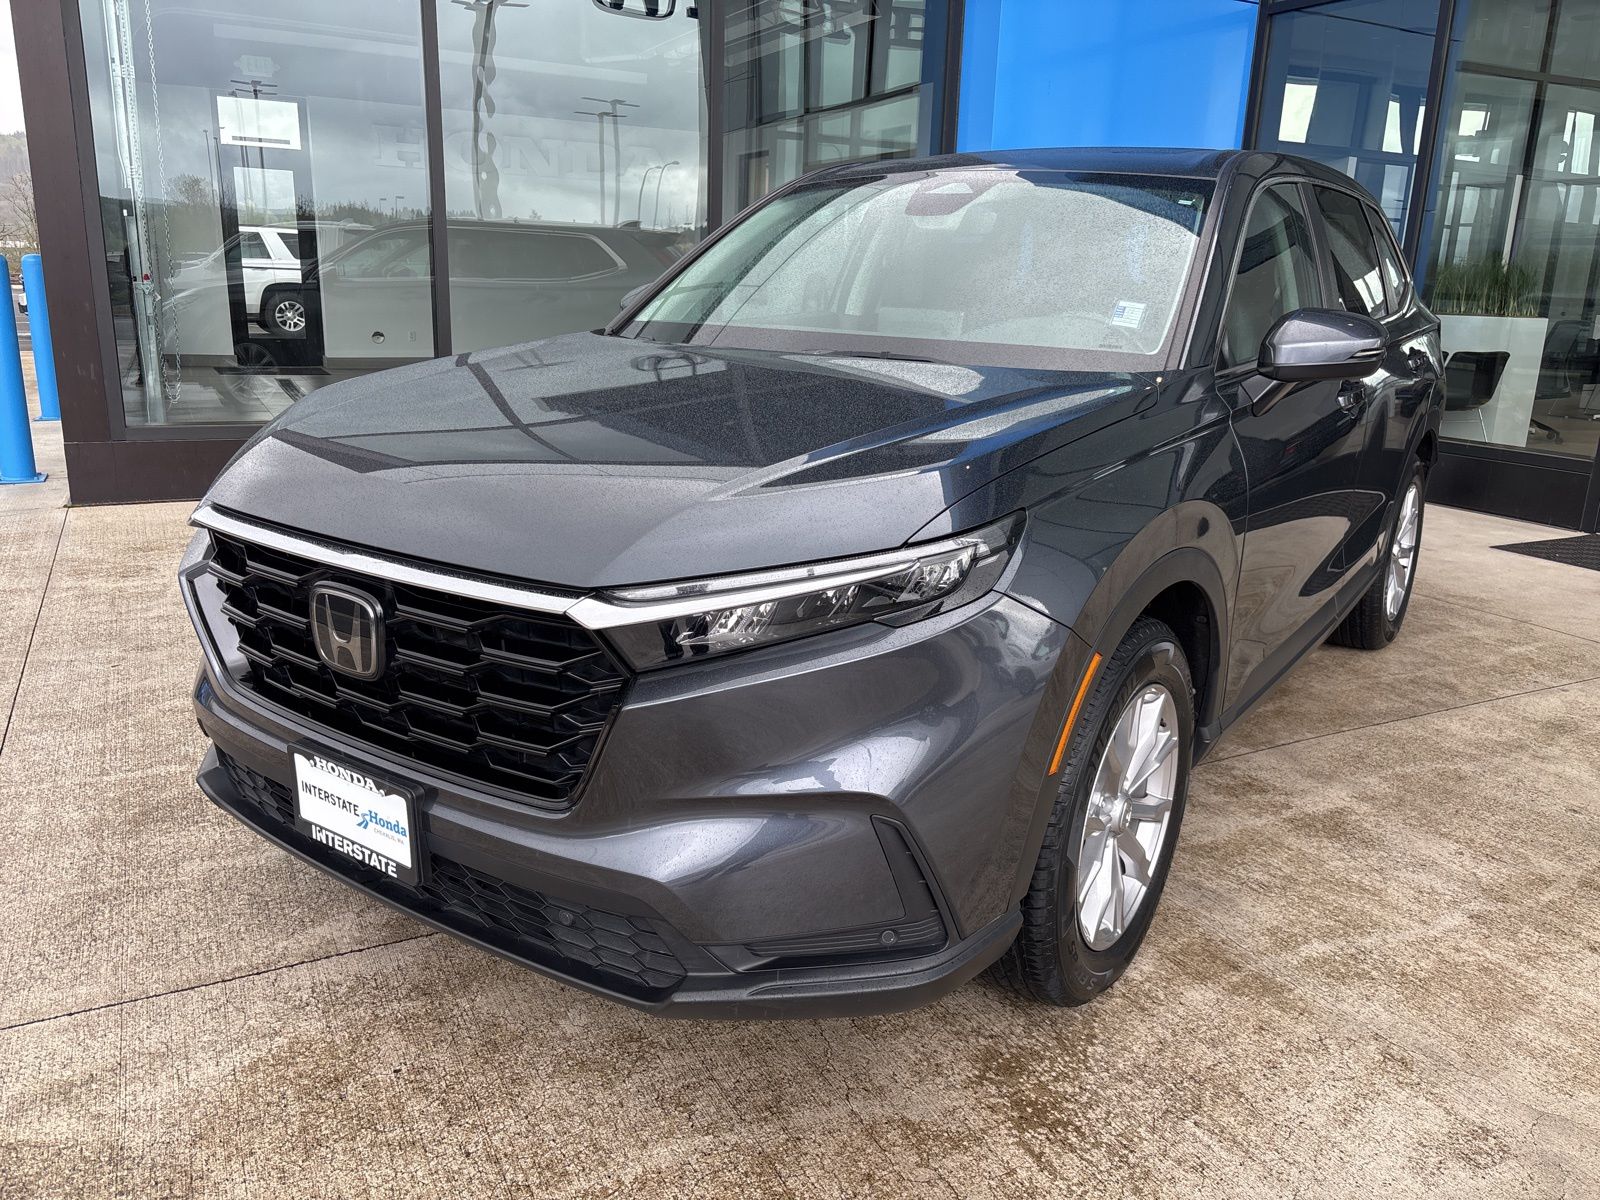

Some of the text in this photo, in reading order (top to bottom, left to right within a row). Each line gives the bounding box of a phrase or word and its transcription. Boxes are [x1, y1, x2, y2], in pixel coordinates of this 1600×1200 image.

[313, 755, 379, 792] HONDA
[301, 780, 360, 817] INTERSTATE
[367, 810, 408, 838] Honda
[311, 824, 399, 878] INTERSTATE
